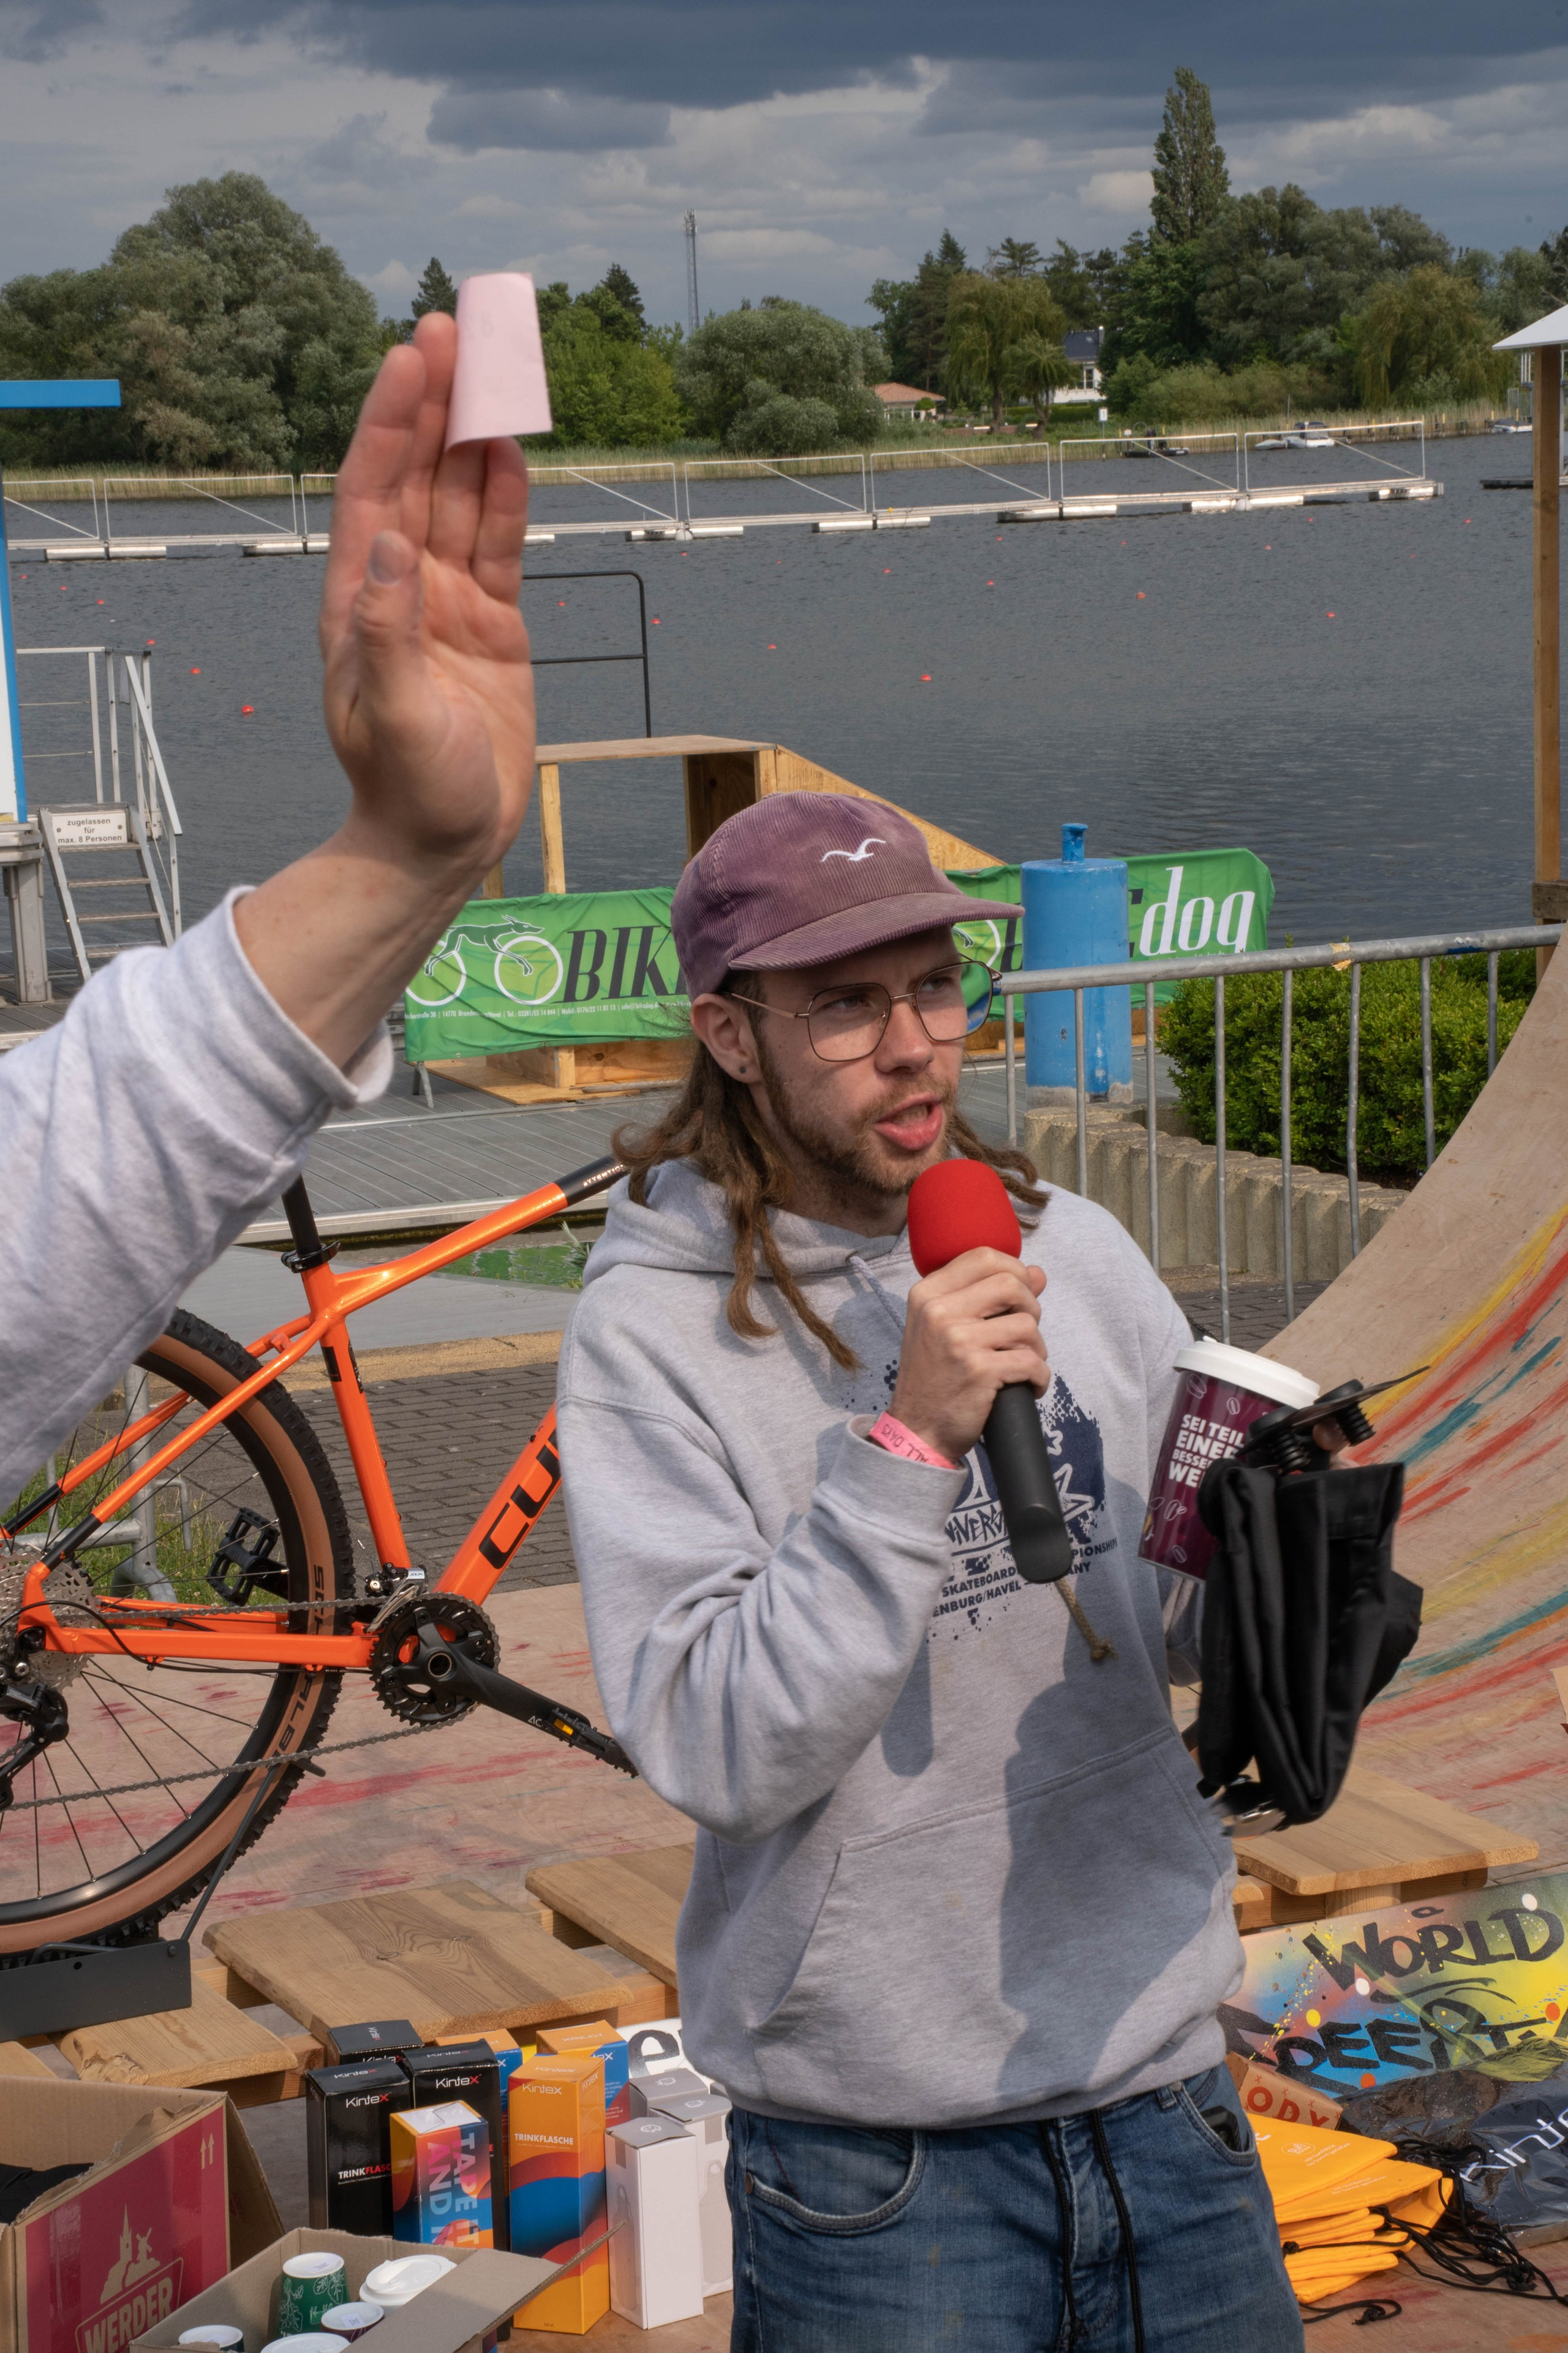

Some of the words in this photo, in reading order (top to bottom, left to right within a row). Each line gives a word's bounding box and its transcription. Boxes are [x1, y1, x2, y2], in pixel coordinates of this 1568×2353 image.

[1130, 866, 1256, 954] dog
[550, 925, 687, 1004] BIK
[881, 1424, 905, 1448] DAYS
[1181, 1414, 1207, 1433] SEI
[1208, 1422, 1244, 1448] TEIL
[1163, 1460, 1202, 1488] WE
[479, 1429, 561, 1569] CU
[942, 1566, 1017, 1598] SKATEBOARD
[1072, 1538, 1117, 1559] PIONSHIPS
[933, 1581, 1022, 1617] ENBURG/HAVEL
[1302, 1908, 1565, 1991] WORLD
[334, 2068, 377, 2079] Kintex
[435, 2075, 480, 2089] Kintex
[522, 2083, 562, 2094] Kintex
[345, 2093, 390, 2109] Kintex
[514, 2132, 573, 2145] TRINKFLASCHE
[338, 2163, 391, 2180] TRINKFLASC
[428, 2142, 452, 2215] AND
[453, 2132, 478, 2213] TAPE
[456, 2219, 480, 2245] IT
[85, 2276, 173, 2353] WERDER
